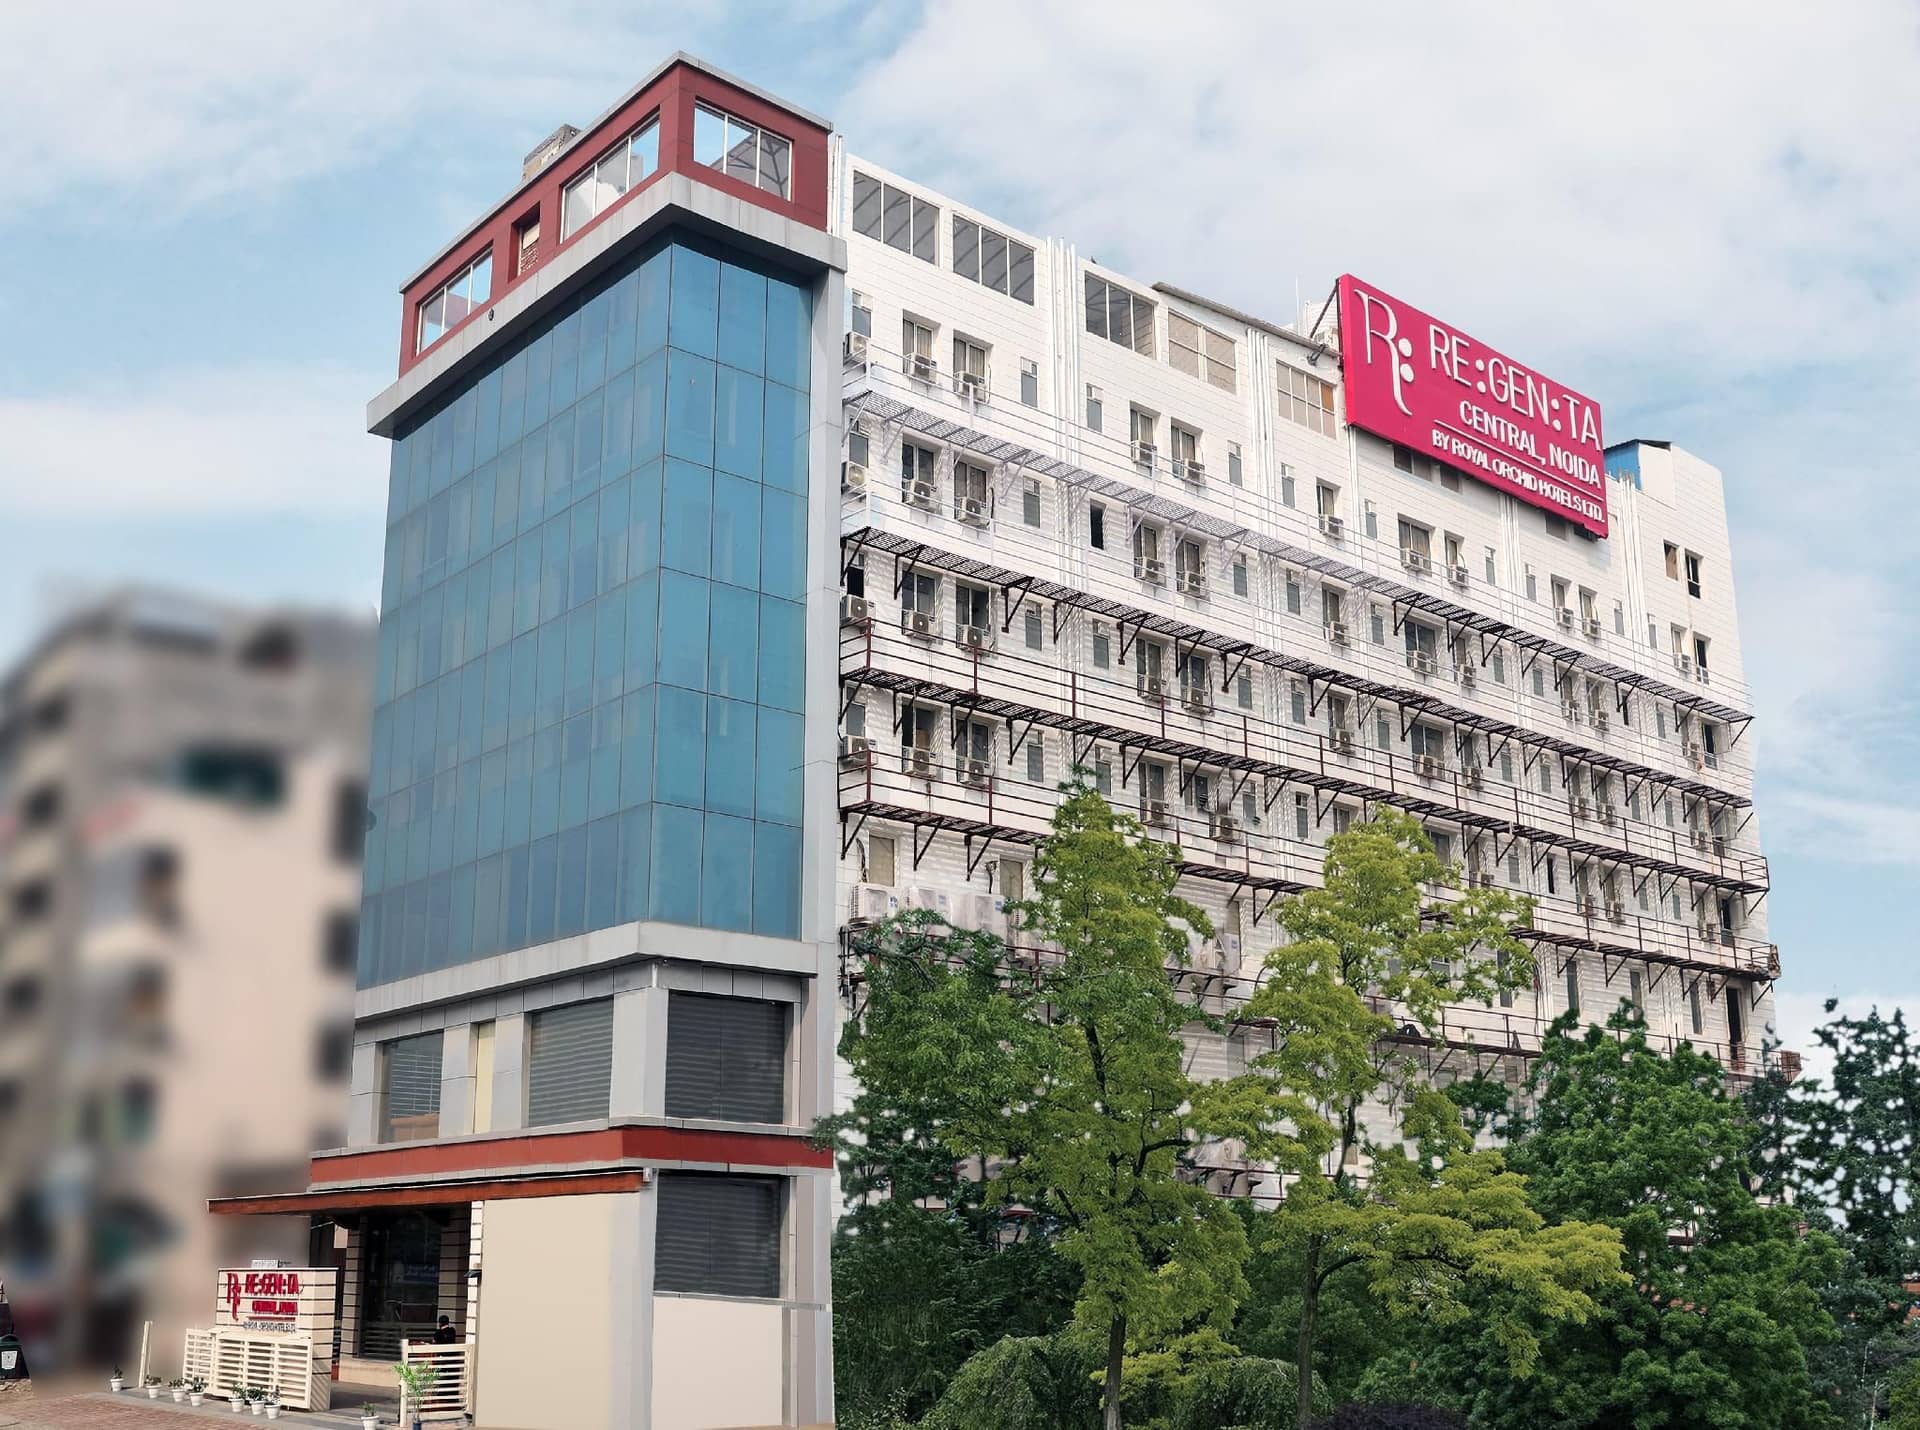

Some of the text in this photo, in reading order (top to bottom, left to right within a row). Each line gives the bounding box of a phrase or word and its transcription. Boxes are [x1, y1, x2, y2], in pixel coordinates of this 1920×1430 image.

[1431, 429, 1605, 523] BY ROYAL ORCHID HOTELS LTD.
[1459, 399, 1602, 489] CENTRAL, NOIDA
